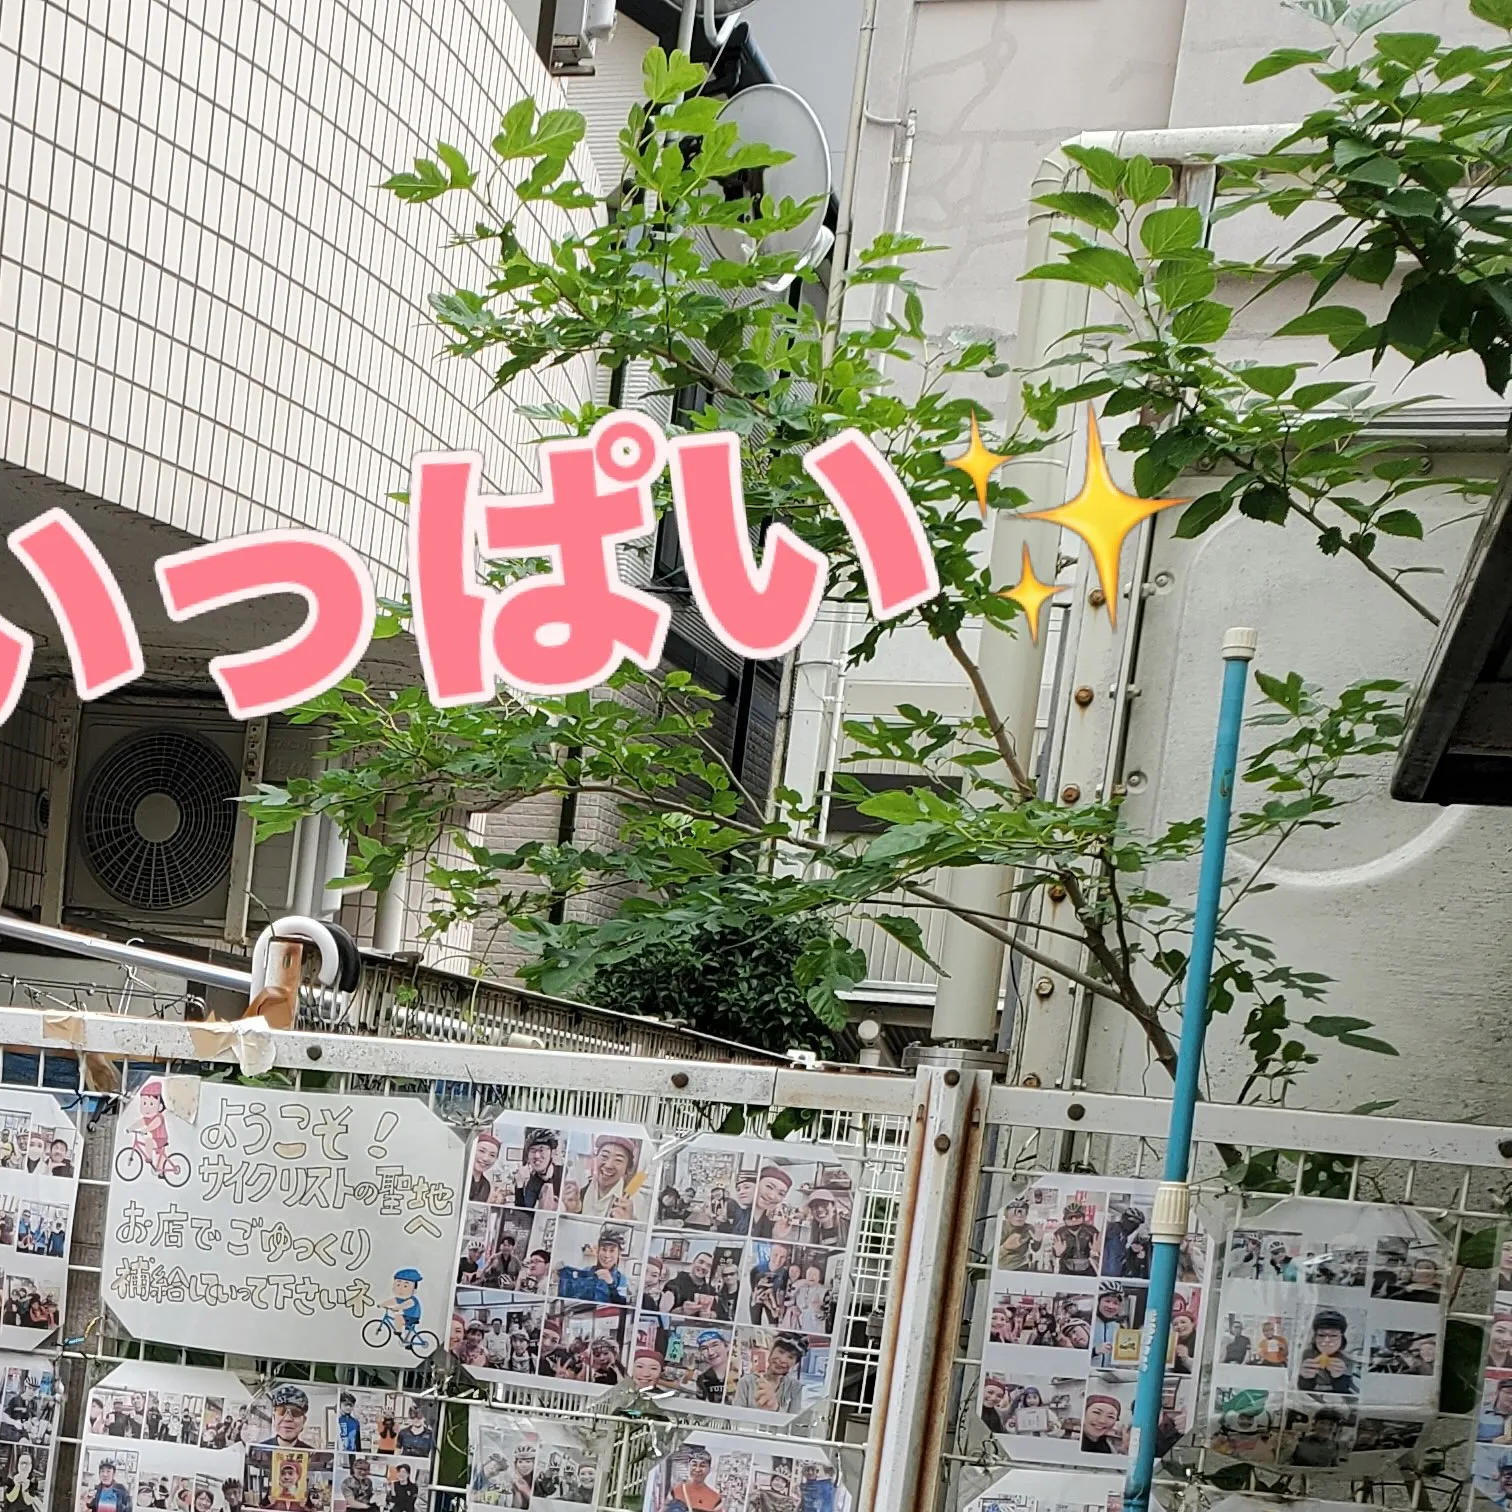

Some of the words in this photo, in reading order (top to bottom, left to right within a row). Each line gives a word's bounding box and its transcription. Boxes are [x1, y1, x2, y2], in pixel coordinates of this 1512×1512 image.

[199, 1155, 455, 1216] サイクリストの聖地
[116, 1200, 372, 1271] お店でごゆっくり
